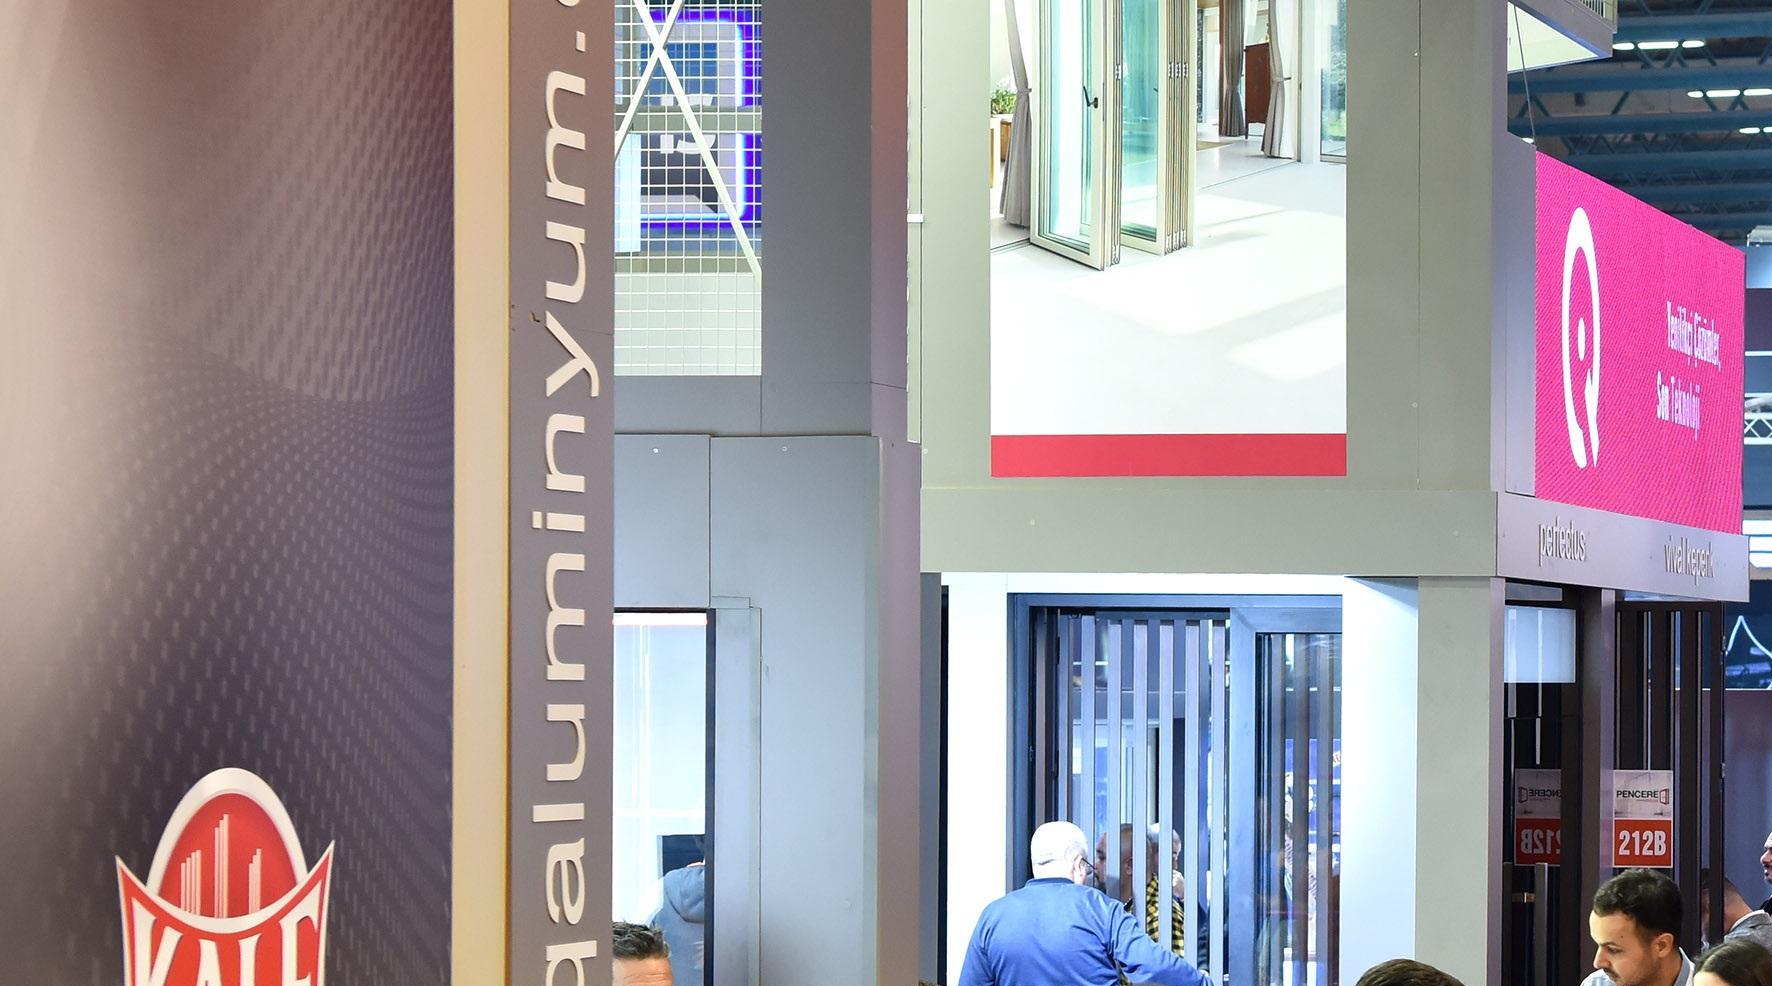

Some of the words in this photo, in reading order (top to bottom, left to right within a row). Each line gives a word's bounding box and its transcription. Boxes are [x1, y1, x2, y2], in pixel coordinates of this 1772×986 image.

[1538, 511, 1587, 567] perfectus
[1616, 789, 1660, 799] PENCERE
[1618, 829, 1667, 856] 212B
